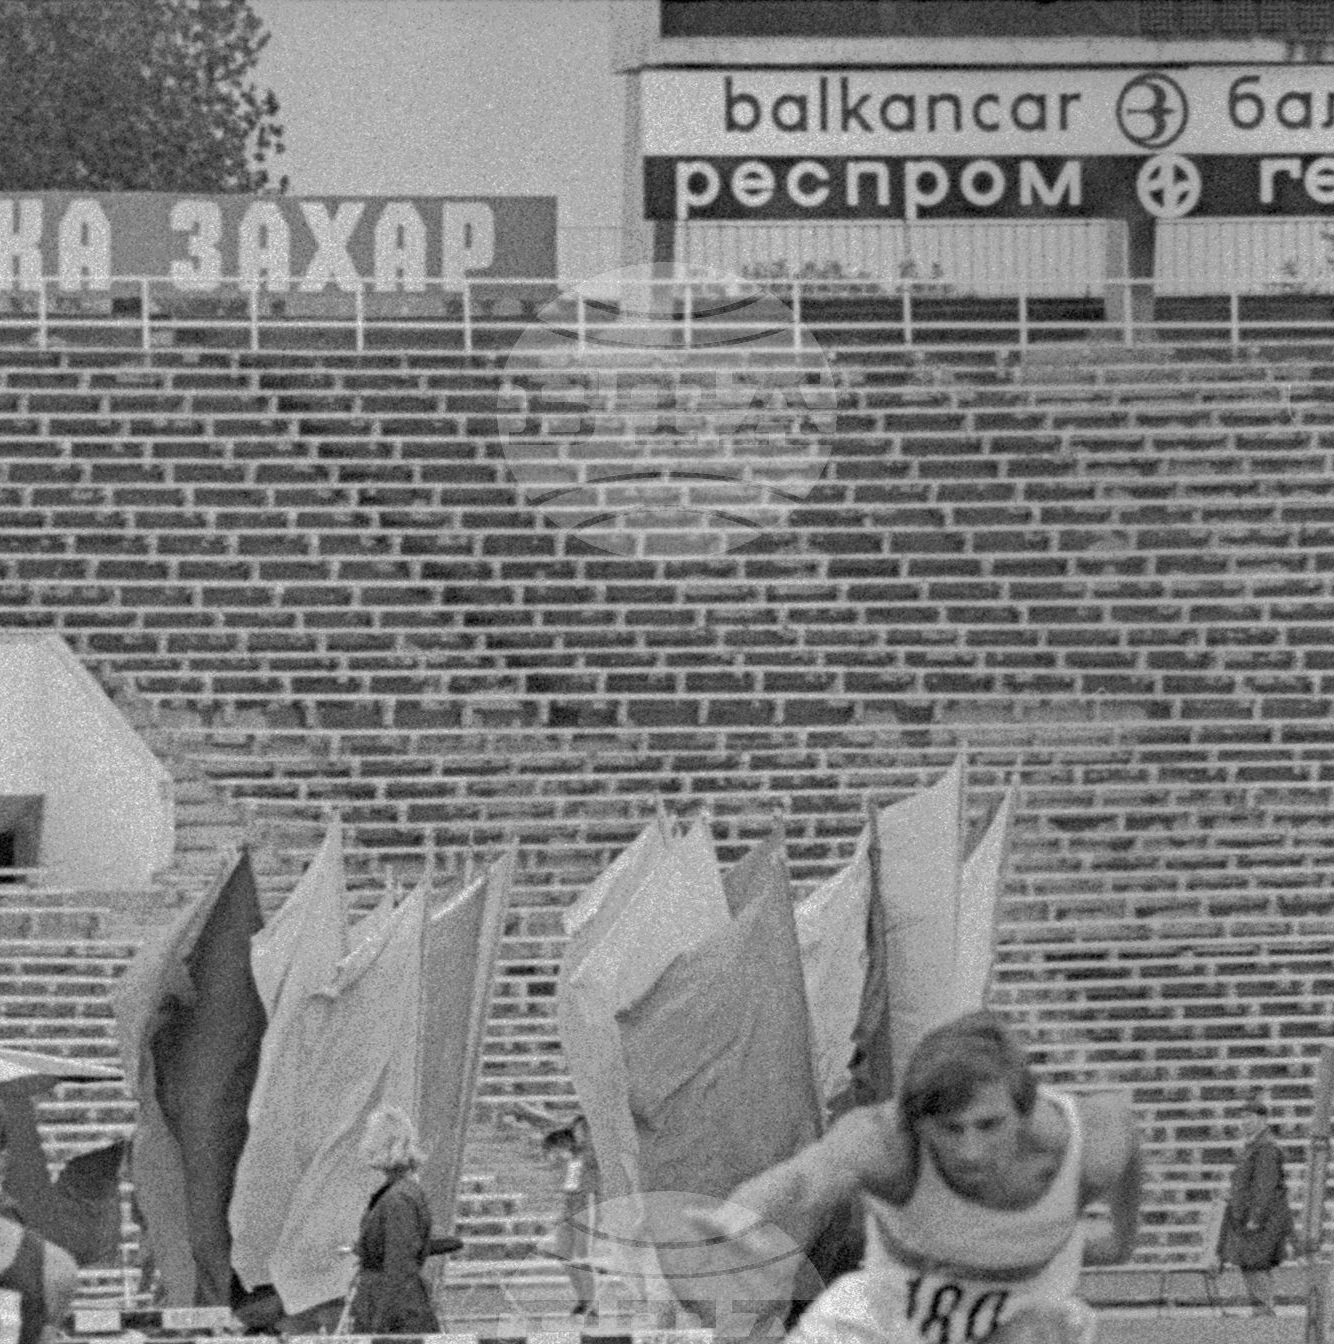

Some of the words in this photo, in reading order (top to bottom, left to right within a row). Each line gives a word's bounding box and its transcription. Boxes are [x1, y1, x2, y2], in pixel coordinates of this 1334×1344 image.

[723, 76, 1083, 134] balkancar
[677, 159, 1083, 221] респром
[168, 200, 496, 293] ЗАХАР
